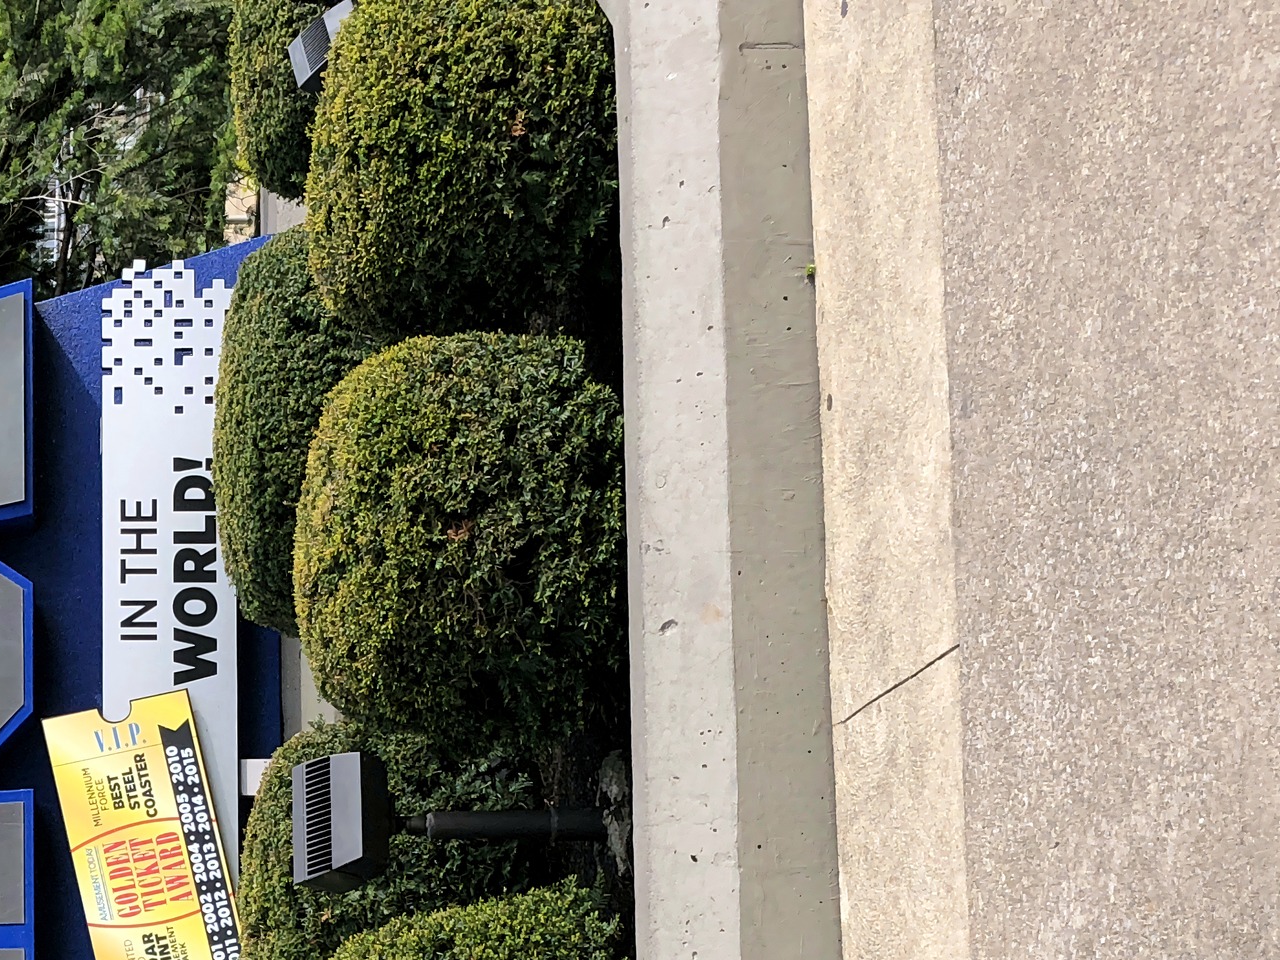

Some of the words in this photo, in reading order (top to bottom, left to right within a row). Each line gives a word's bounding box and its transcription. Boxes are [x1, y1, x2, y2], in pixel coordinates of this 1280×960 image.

[120, 499, 157, 584] THE
[172, 457, 217, 686] WORLD!
[120, 600, 157, 641] IN
[165, 746, 184, 784] 2010
[181, 747, 199, 784] 2015
[82, 768, 103, 827] MILLENNIUM
[96, 779, 109, 811] FORCE
[107, 775, 125, 810] BEST
[122, 767, 140, 811] STEEL
[134, 753, 158, 818] COASTER
[178, 793, 196, 832] 2005
[192, 795, 211, 831] 2014
[86, 848, 97, 873] TODAY
[102, 840, 142, 918] GOLDEN
[129, 837, 167, 912] TICKET
[155, 832, 194, 902] AWARD
[189, 843, 208, 883] 2004
[202, 843, 221, 879] 2013
[92, 873, 108, 921] AMUSEMENT
[200, 893, 218, 933] 2002
[213, 890, 232, 927] 2012
